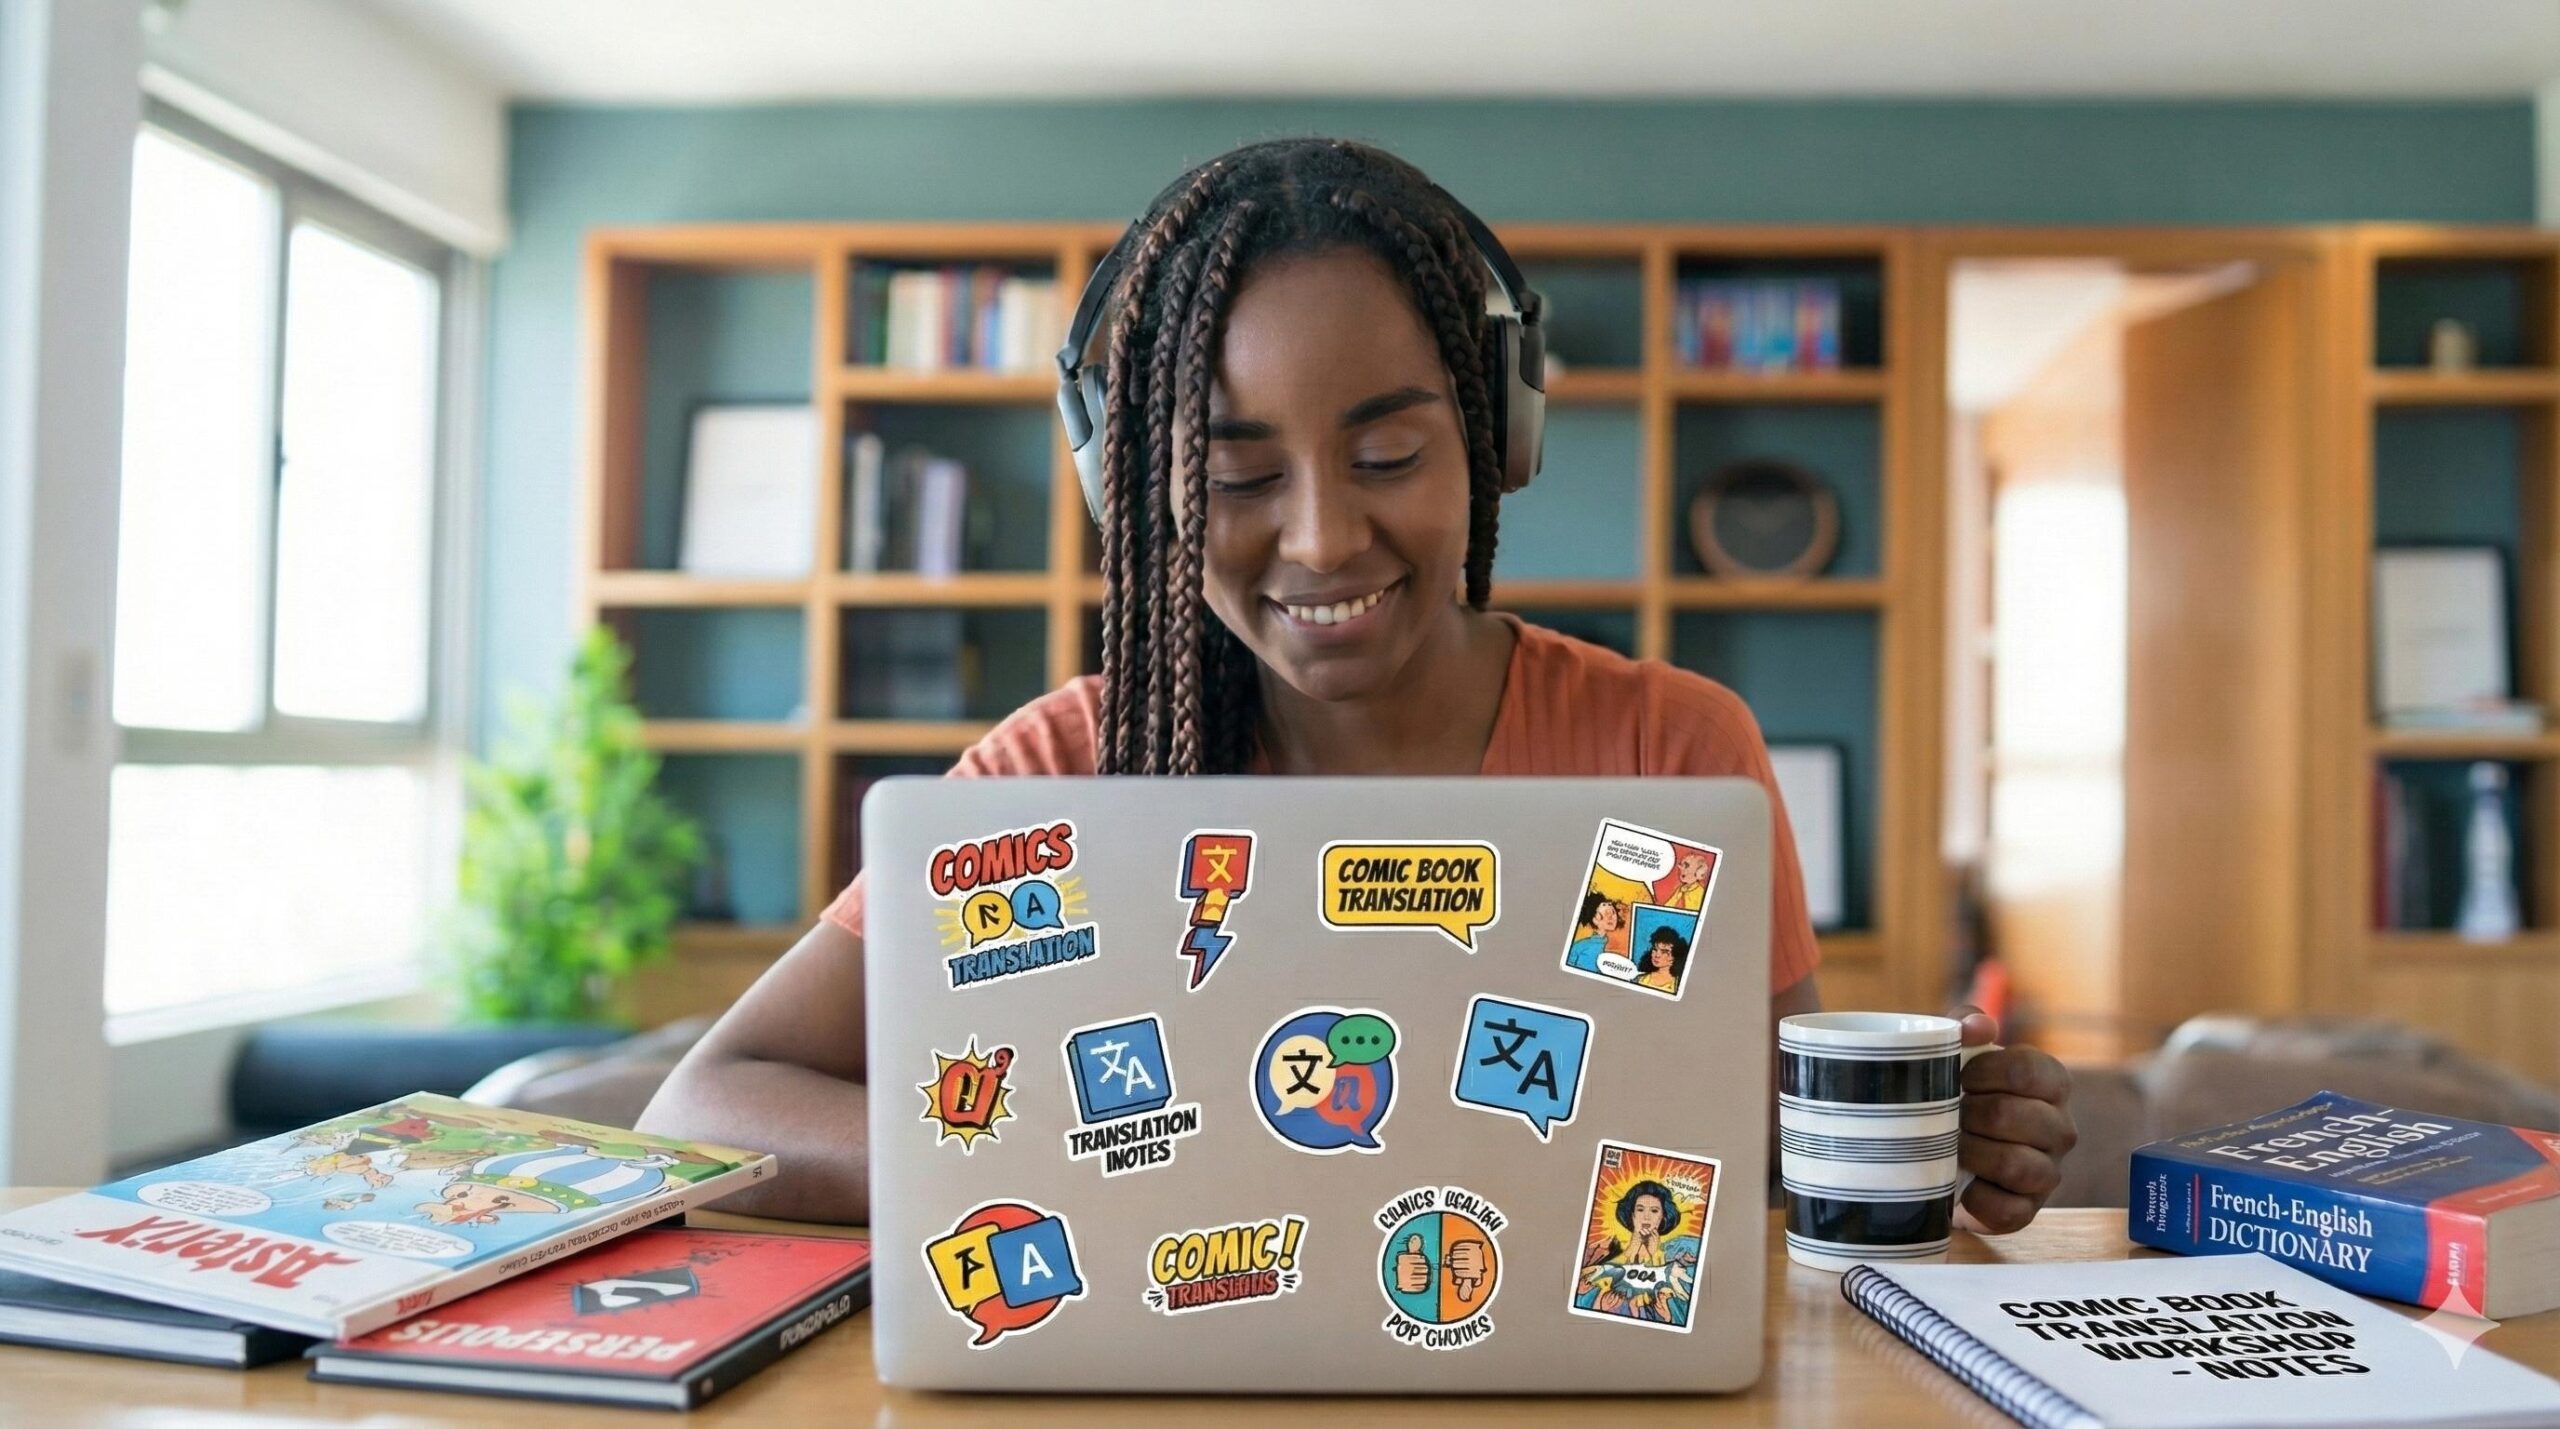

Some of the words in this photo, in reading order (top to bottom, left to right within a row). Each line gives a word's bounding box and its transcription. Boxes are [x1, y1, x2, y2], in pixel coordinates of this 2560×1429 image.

[931, 823, 1073, 895] COMICS
[1338, 858, 1410, 883] COMIC
[1415, 857, 1482, 883] BOOK
[1338, 888, 1484, 912] TRANSLATION
[949, 926, 1095, 988] TRANSLATION
[1069, 1107, 1197, 1156] TRANSLATION
[2263, 1119, 2454, 1172] English
[2209, 1183, 2373, 1239] French-English
[74, 1215, 363, 1290] Asterix
[2208, 1216, 2373, 1274] DICTIONARY
[1387, 1313, 1421, 1342] POP
[2000, 1296, 2158, 1320] COMIC
[2157, 1290, 2298, 1314] BOOK
[2016, 1310, 2355, 1341] TRANSLATION
[388, 1318, 697, 1363] PERSEPOLIS
[2083, 1331, 2356, 1361] WORKSHOP
[2197, 1355, 2371, 1380] NOTES
